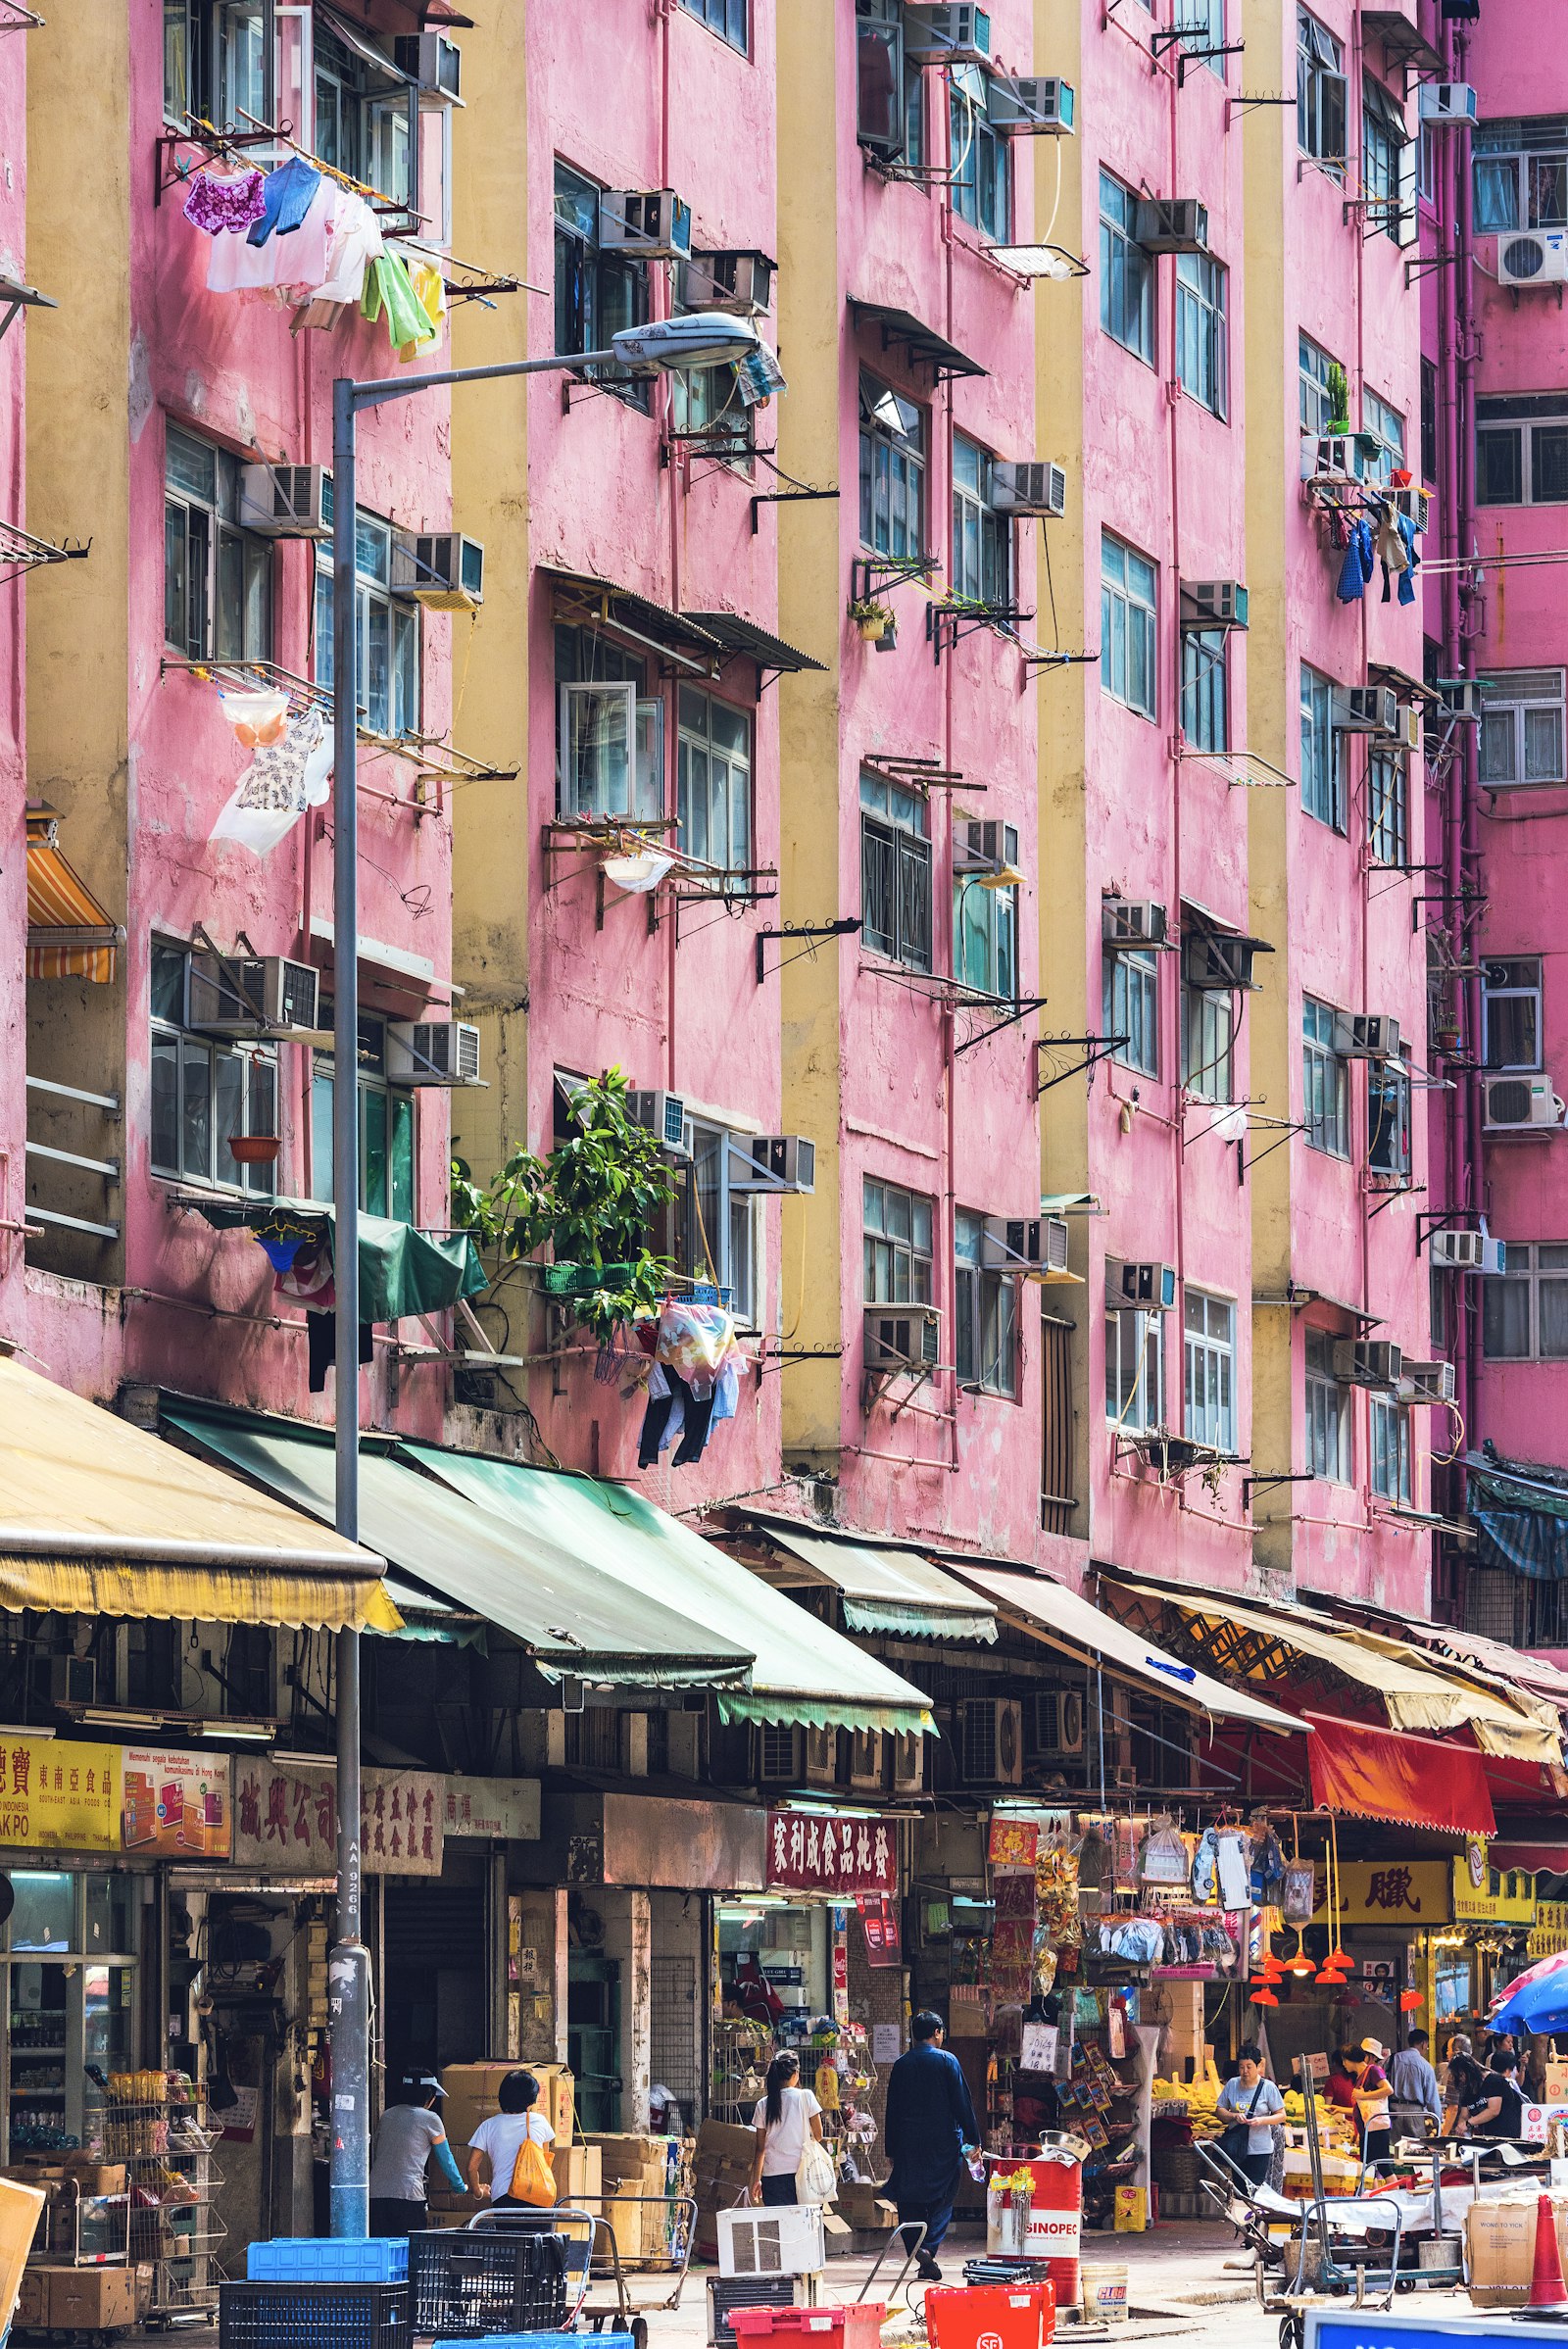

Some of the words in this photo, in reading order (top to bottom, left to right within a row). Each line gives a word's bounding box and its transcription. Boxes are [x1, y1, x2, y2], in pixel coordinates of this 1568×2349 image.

[39, 1765, 112, 1795] 東南亞食品
[13, 1815, 29, 1837] PO
[348, 1871, 358, 1914] 9266
[1027, 2222, 1077, 2235] SINOPEC
